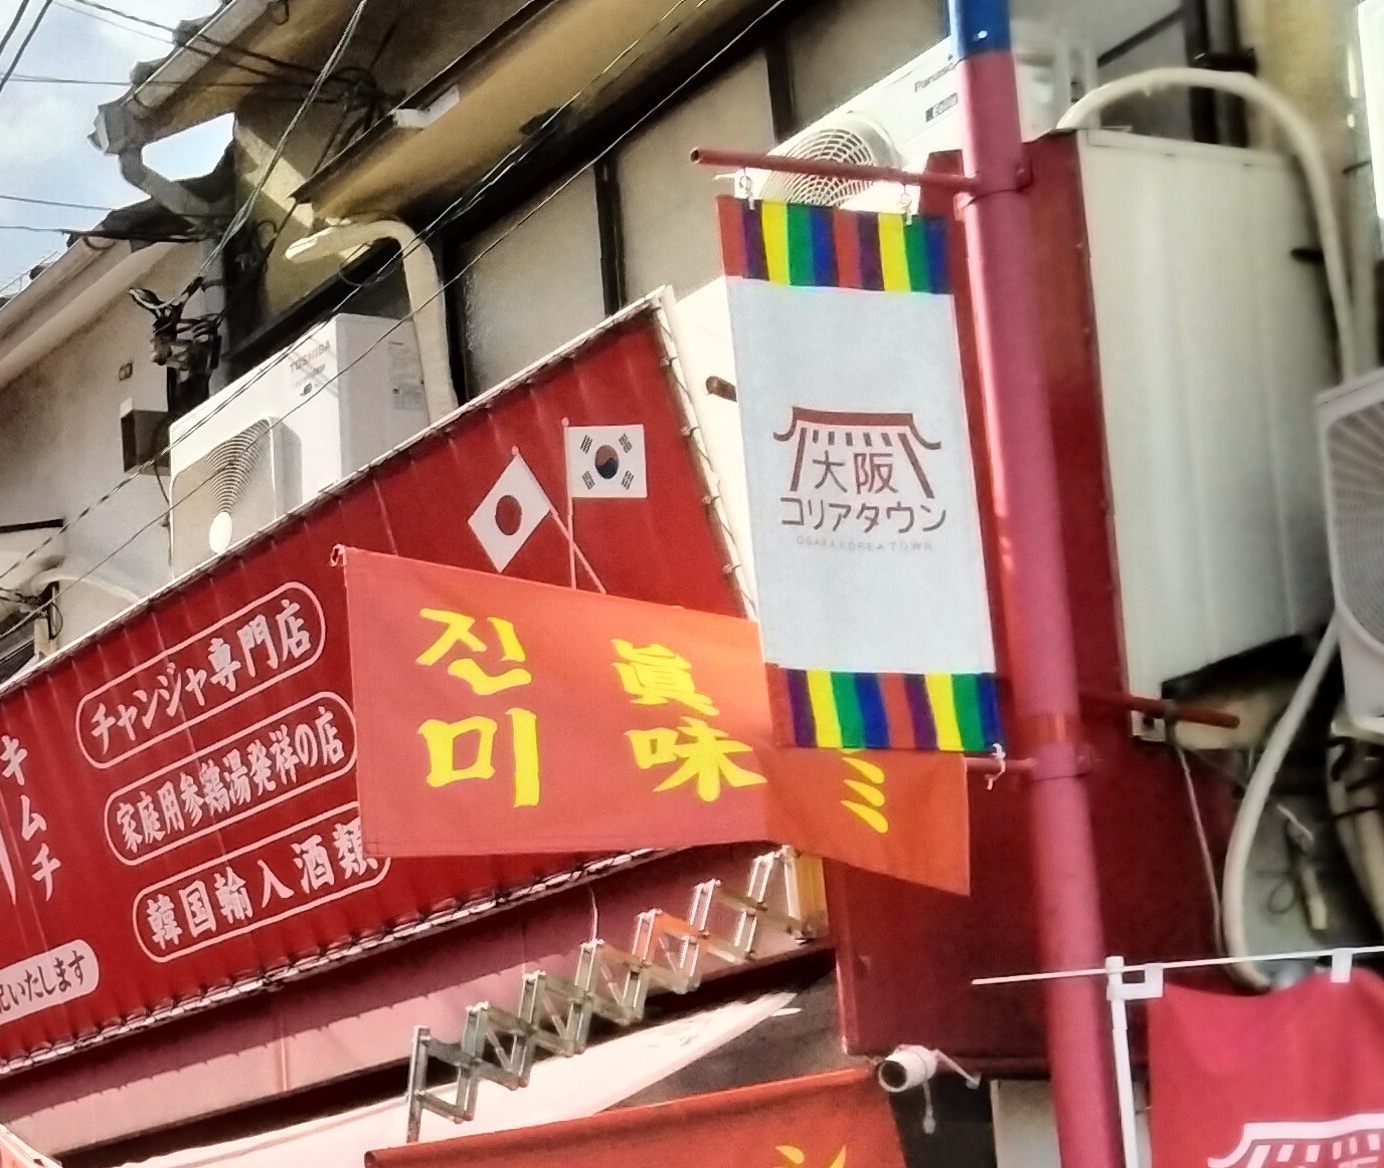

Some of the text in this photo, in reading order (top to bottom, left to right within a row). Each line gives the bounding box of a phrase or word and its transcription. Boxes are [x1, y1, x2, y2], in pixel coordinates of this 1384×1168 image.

[780, 497, 947, 534] コリアタウン
[812, 450, 899, 496] 大阪
[888, 541, 933, 552] TOWN
[91, 600, 312, 755] チャンジャ専門店
[416, 608, 539, 808] 진미
[0, 735, 62, 901] キムチ
[115, 706, 345, 854] 家庭用参鶏湯発祥の店
[145, 814, 379, 949] 韓国輸入酒類
